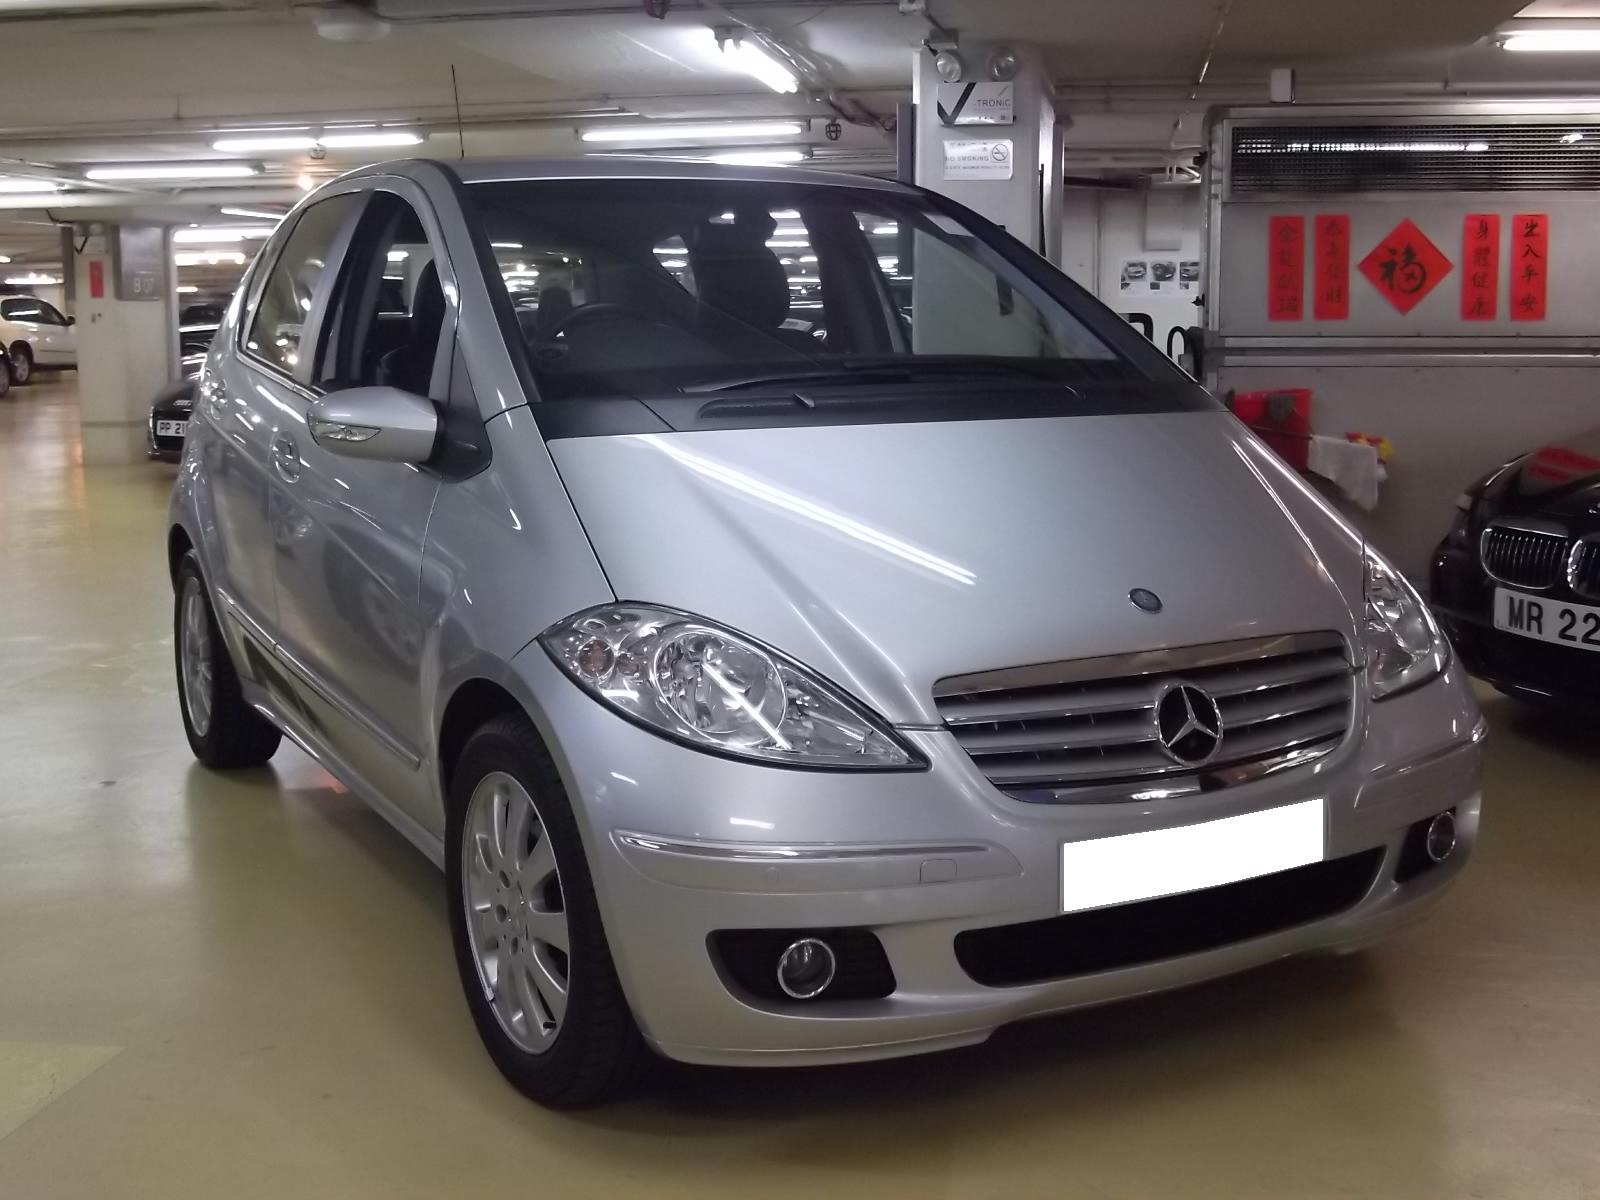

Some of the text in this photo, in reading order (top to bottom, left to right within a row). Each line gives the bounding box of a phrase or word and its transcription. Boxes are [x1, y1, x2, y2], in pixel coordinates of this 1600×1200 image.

[1380, 242, 1427, 293] 福
[1508, 597, 1600, 647] MR 22
